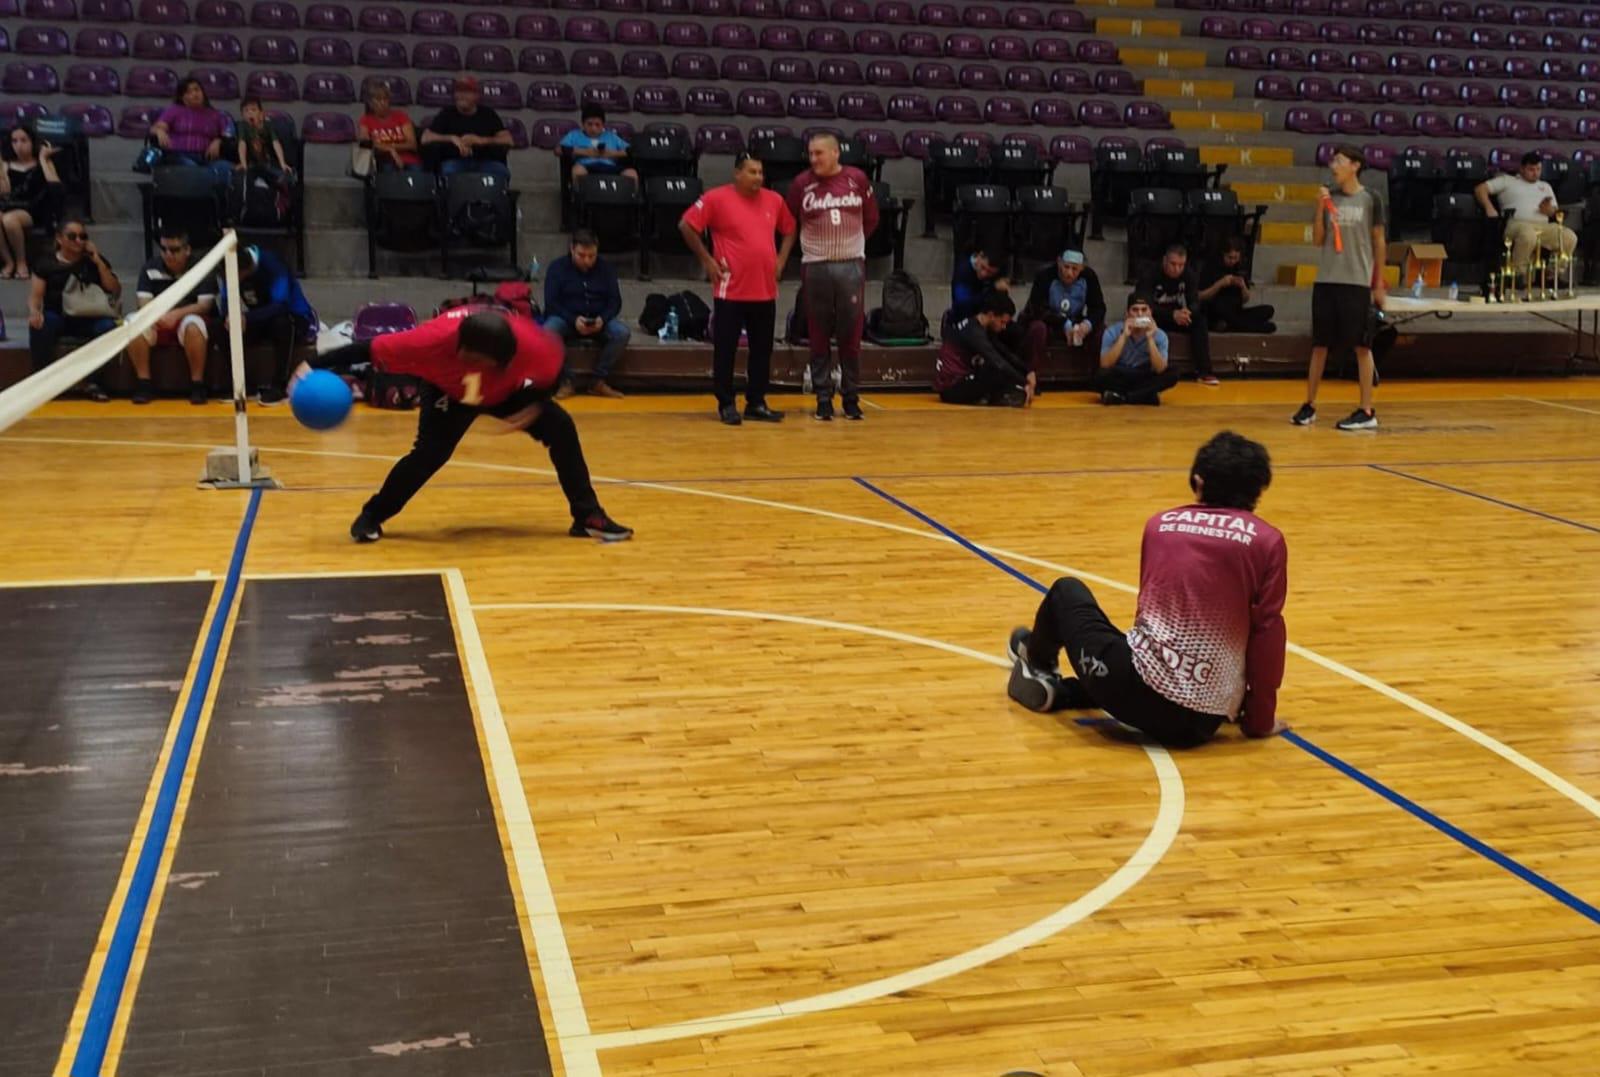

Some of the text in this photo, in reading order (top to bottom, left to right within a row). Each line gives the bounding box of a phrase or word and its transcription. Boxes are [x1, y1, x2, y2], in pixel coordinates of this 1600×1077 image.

[461, 371, 484, 406] 1
[1158, 522, 1253, 546] DE BIENESTAR
[1160, 510, 1258, 536] CAPITAL
